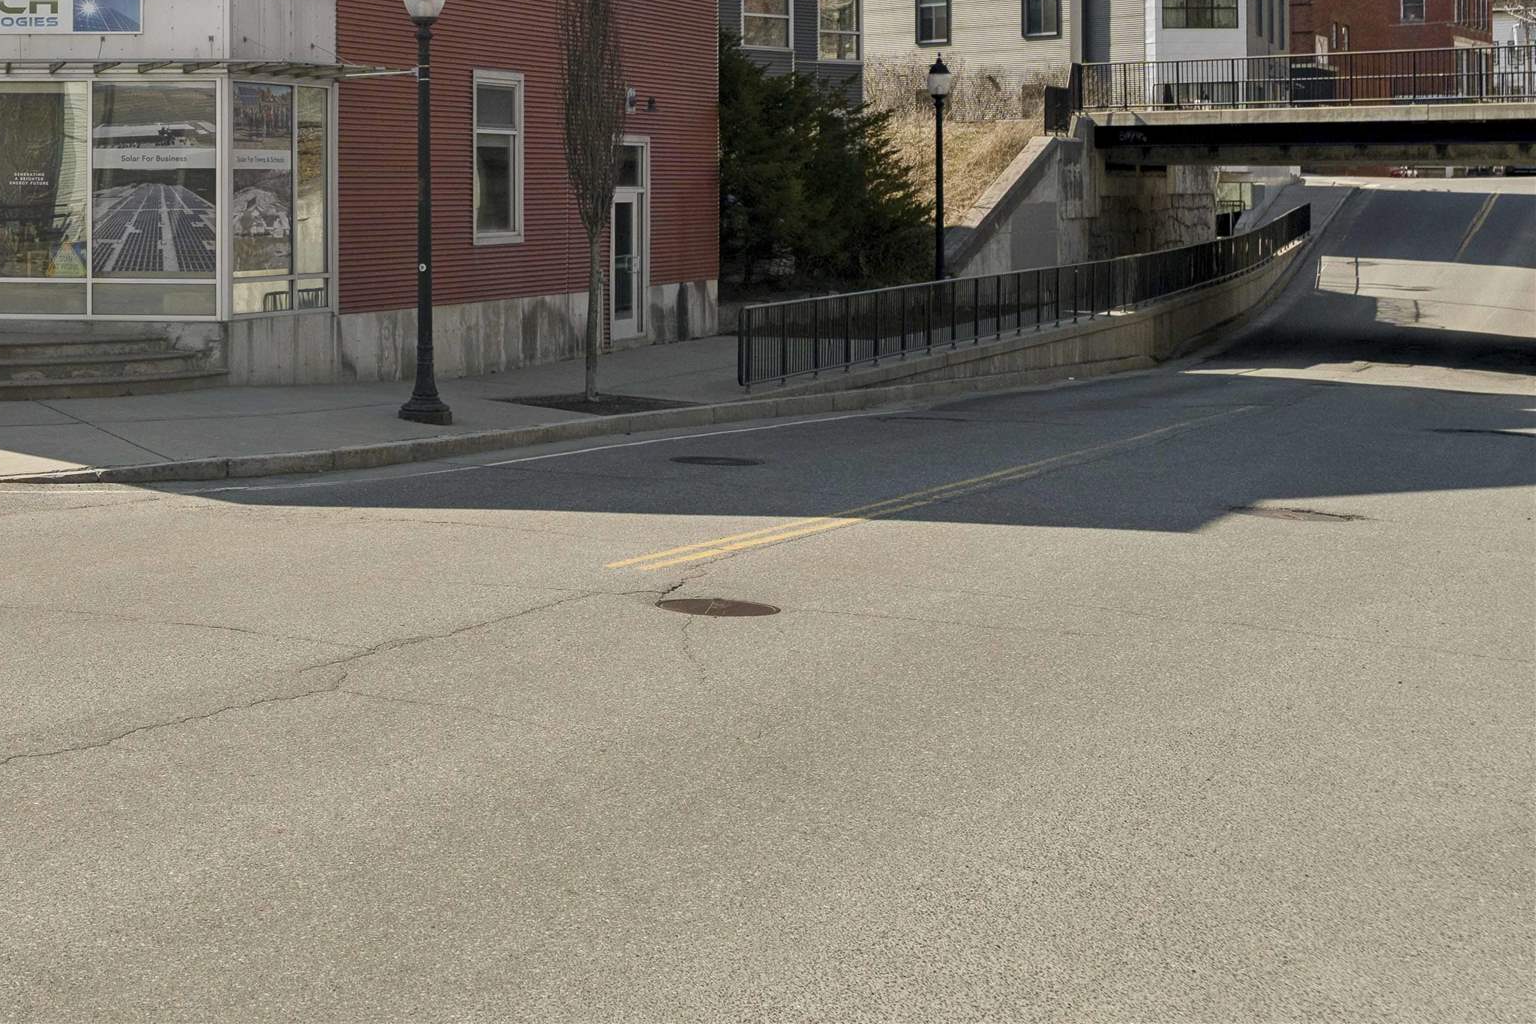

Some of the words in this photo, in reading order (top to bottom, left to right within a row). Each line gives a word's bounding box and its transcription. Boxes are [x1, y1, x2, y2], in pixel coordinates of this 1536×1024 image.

[121, 154, 139, 162] Solar
[141, 154, 154, 162] For
[155, 154, 188, 162] Business
